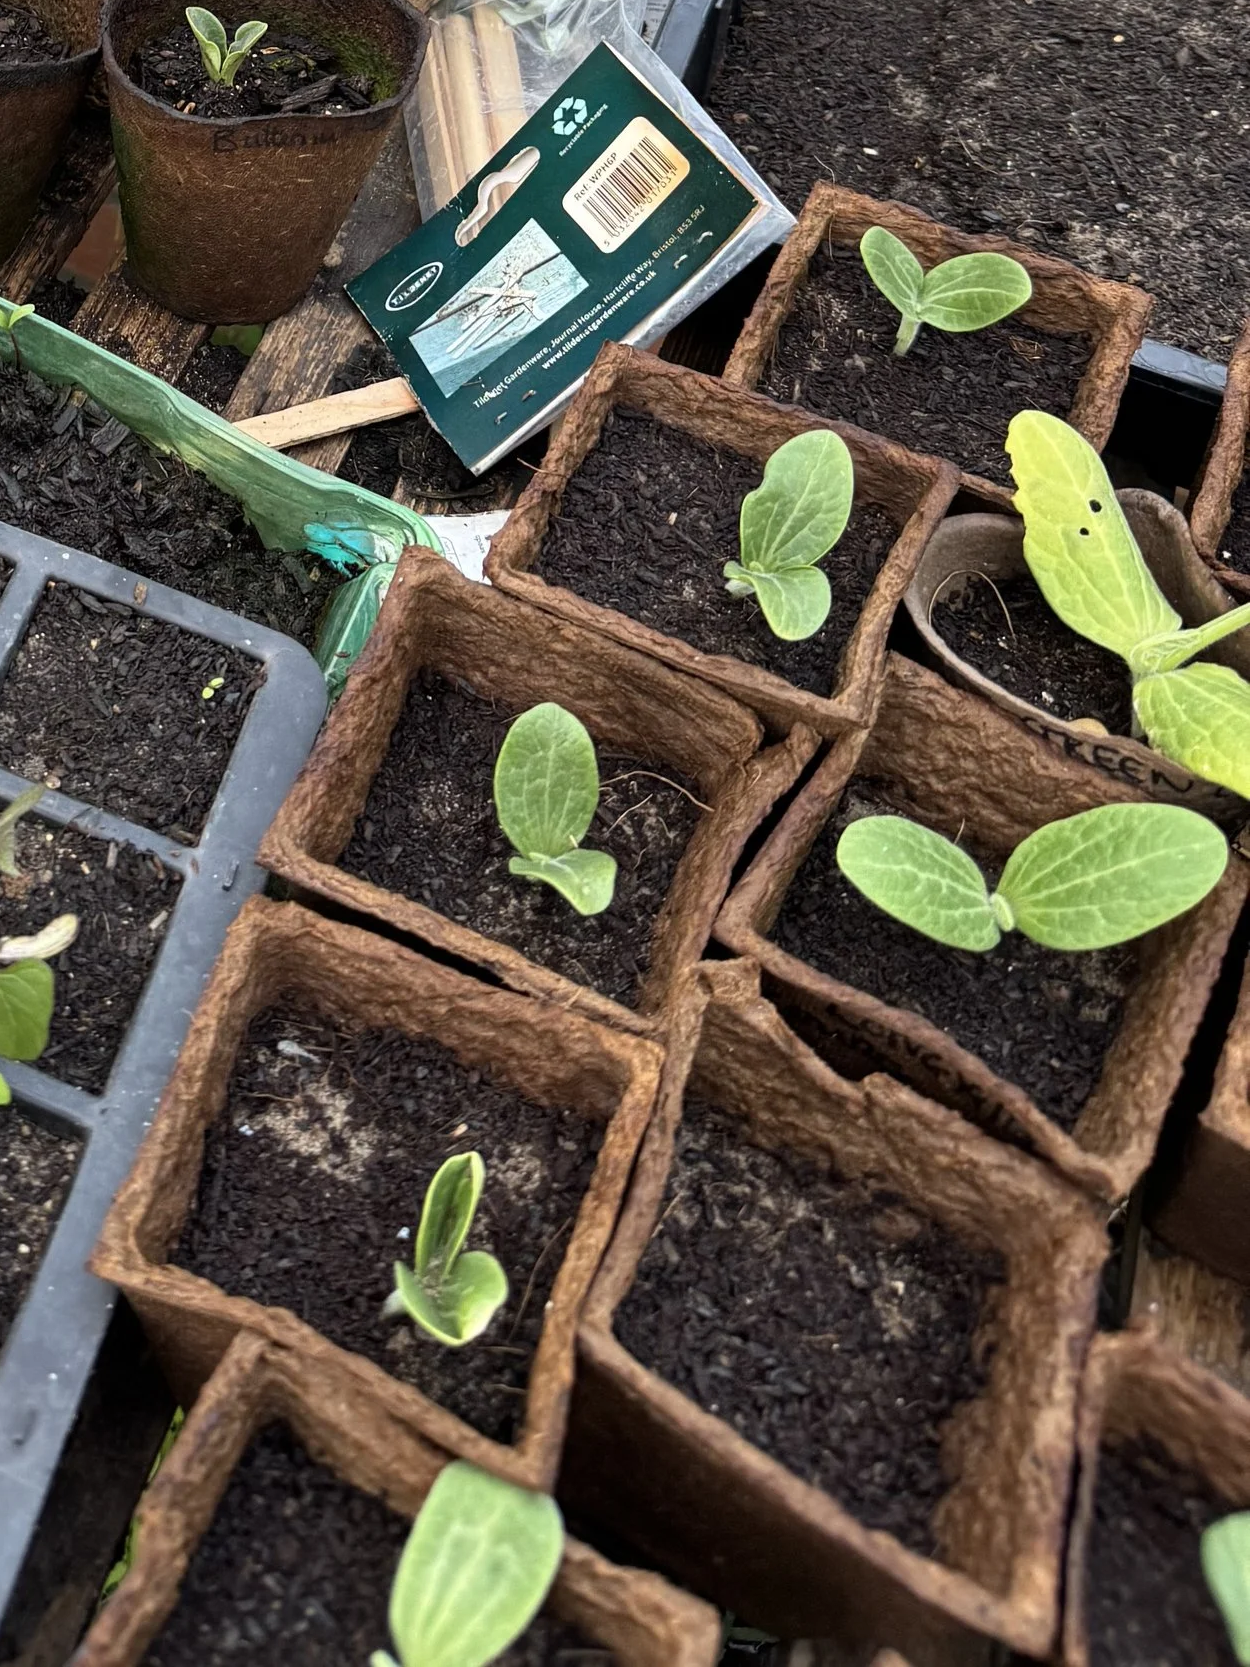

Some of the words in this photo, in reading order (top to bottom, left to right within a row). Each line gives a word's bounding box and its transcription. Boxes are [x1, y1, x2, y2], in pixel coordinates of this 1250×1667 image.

[573, 183, 591, 202] Ref:
[390, 267, 441, 307] TILDENET
[504, 345, 551, 385] Gardenware,
[550, 322, 579, 350] Journal
[578, 304, 605, 330] House,
[603, 273, 638, 306] Hartcliffe
[635, 257, 655, 277] Way,
[652, 232, 680, 261] Bristol,
[677, 215, 694, 236] BS3
[689, 204, 706, 223] 5RJ
